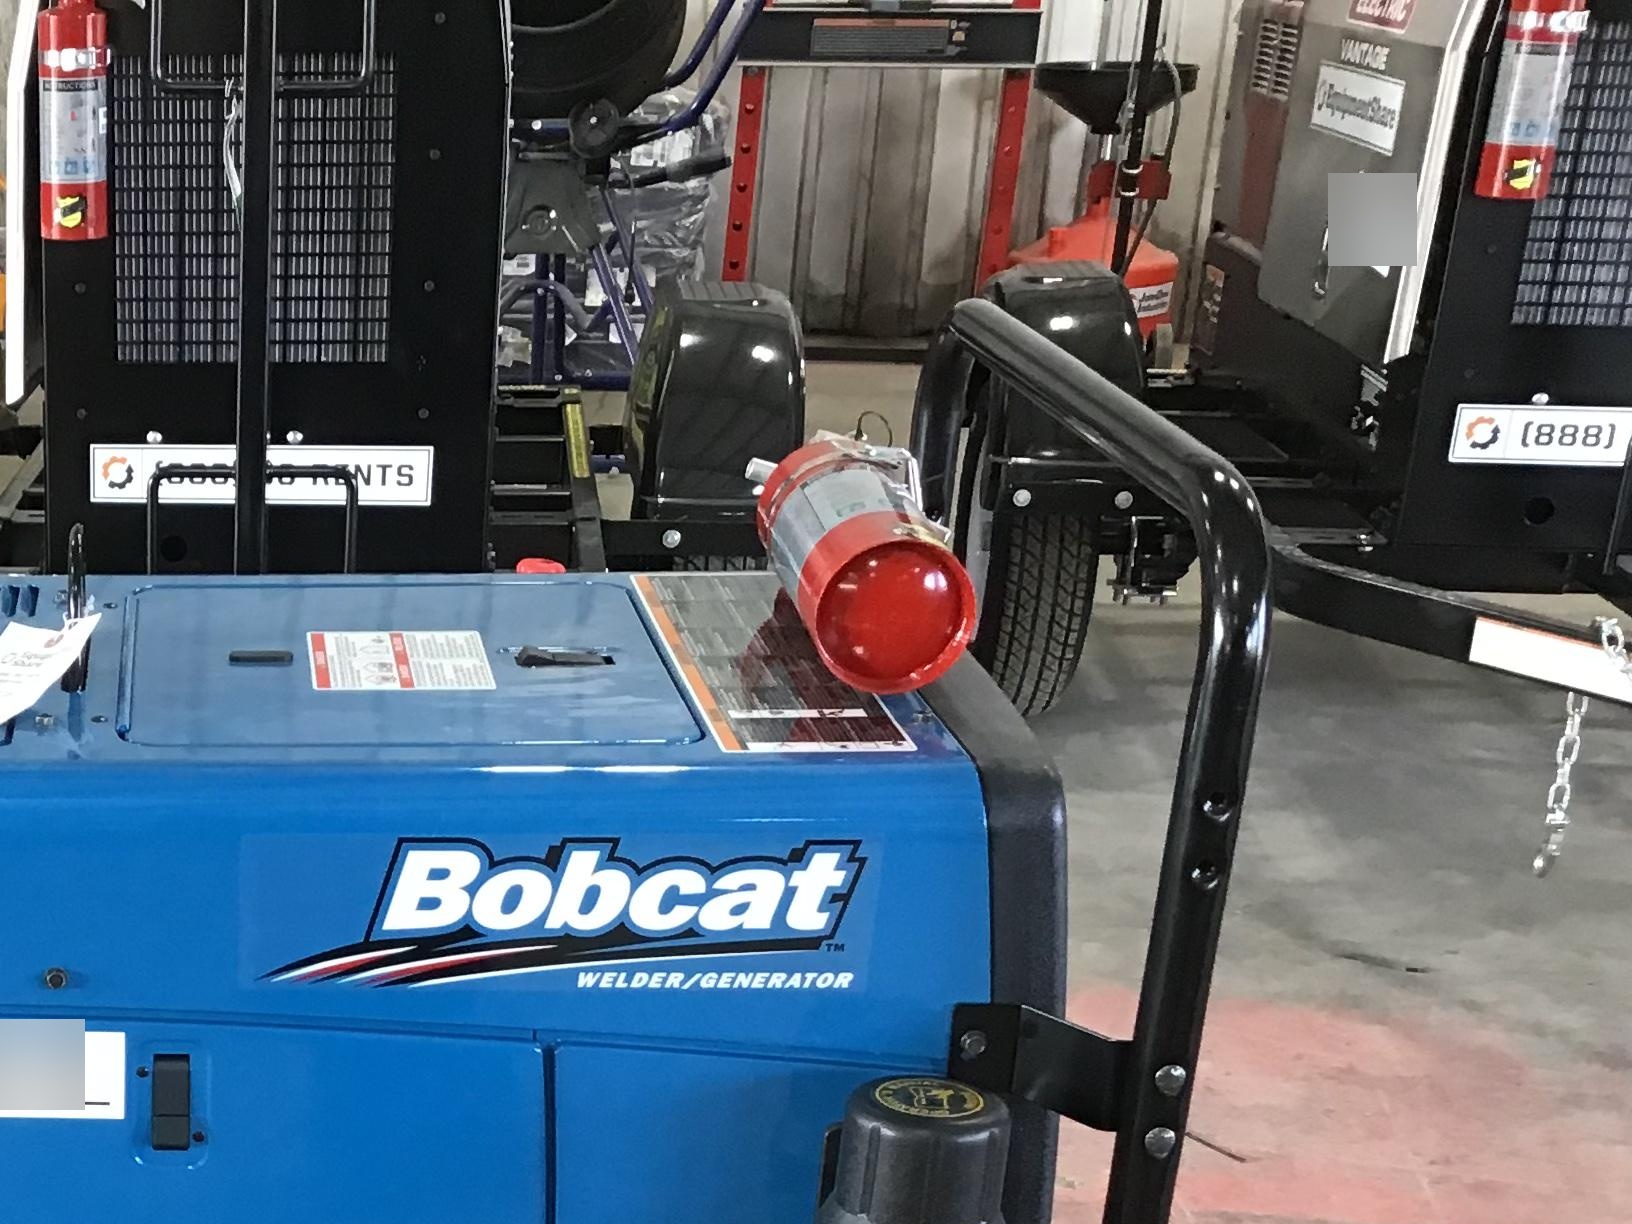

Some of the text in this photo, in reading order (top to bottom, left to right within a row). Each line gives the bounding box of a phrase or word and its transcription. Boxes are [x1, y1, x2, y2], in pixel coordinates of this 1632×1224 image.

[1520, 421, 1616, 449] (888)
[381, 849, 850, 933] Bobcat
[576, 971, 855, 990] WELDER/GENERATOR
